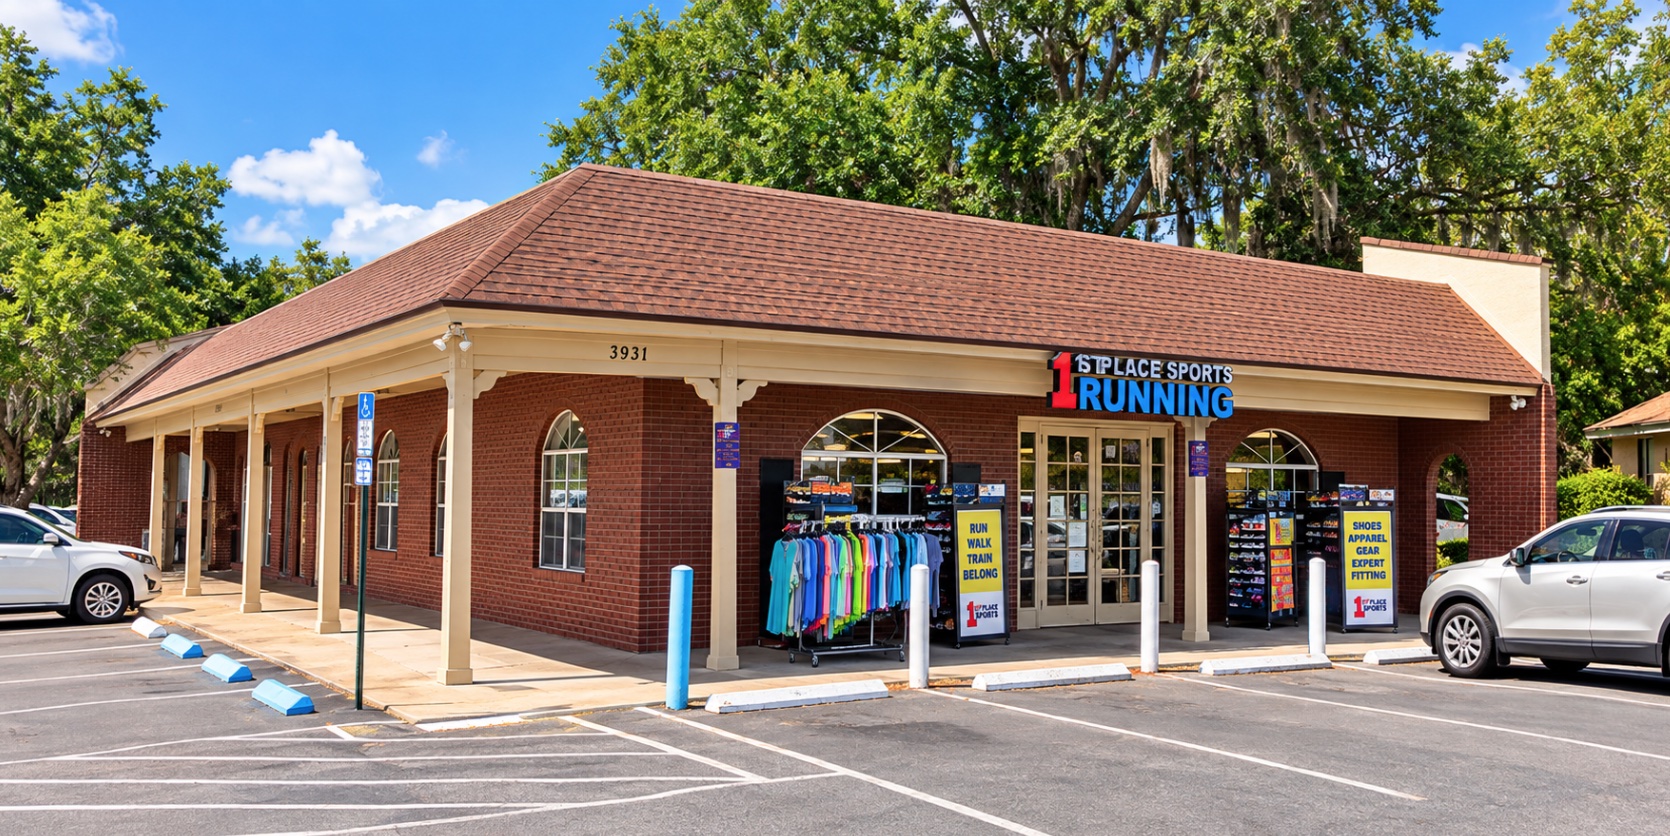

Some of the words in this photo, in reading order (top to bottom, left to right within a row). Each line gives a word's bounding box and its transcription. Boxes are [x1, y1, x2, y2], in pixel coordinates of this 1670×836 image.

[609, 345, 647, 361] 3931
[1166, 361, 1233, 384] SPORTS
[1079, 376, 1234, 419] RUNNING
[970, 523, 988, 534] RUN
[1353, 521, 1382, 531] SHOES
[967, 538, 992, 549] WALK
[1348, 534, 1387, 543] APPAREL
[1356, 547, 1380, 555] GEAR
[967, 553, 992, 564] TRAIN
[1351, 559, 1385, 568] EXPERT
[963, 568, 998, 580] BELONG
[1351, 571, 1386, 580] FITTING
